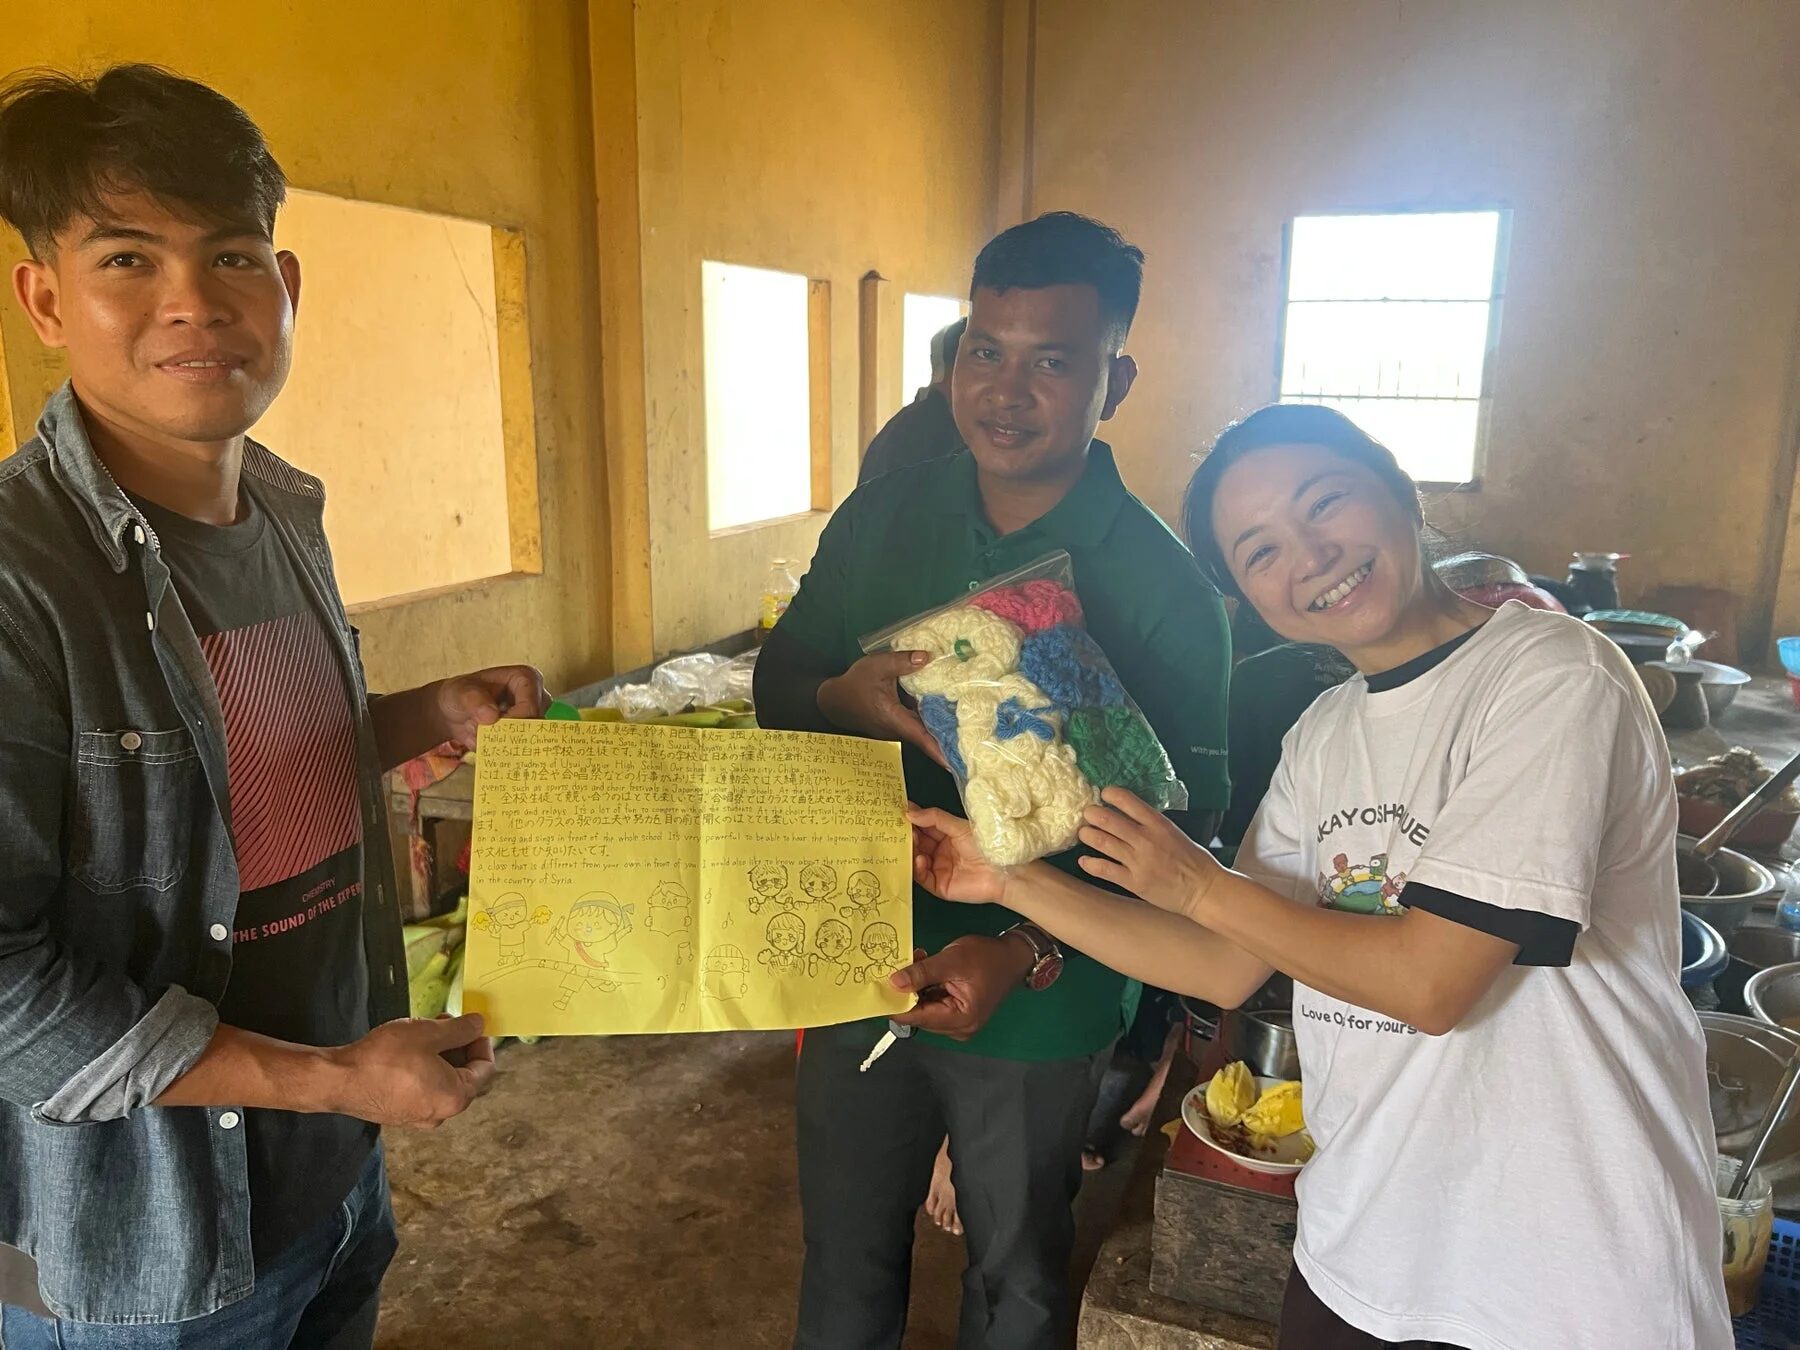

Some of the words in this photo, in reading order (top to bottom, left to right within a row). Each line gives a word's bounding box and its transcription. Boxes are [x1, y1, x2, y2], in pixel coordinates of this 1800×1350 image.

[233, 928, 258, 944] THE
[262, 912, 306, 938] SOUND
[307, 906, 318, 922] OF
[318, 897, 337, 916] THE
[1301, 1004, 1331, 1023] Love
[1347, 1015, 1373, 1030] for
